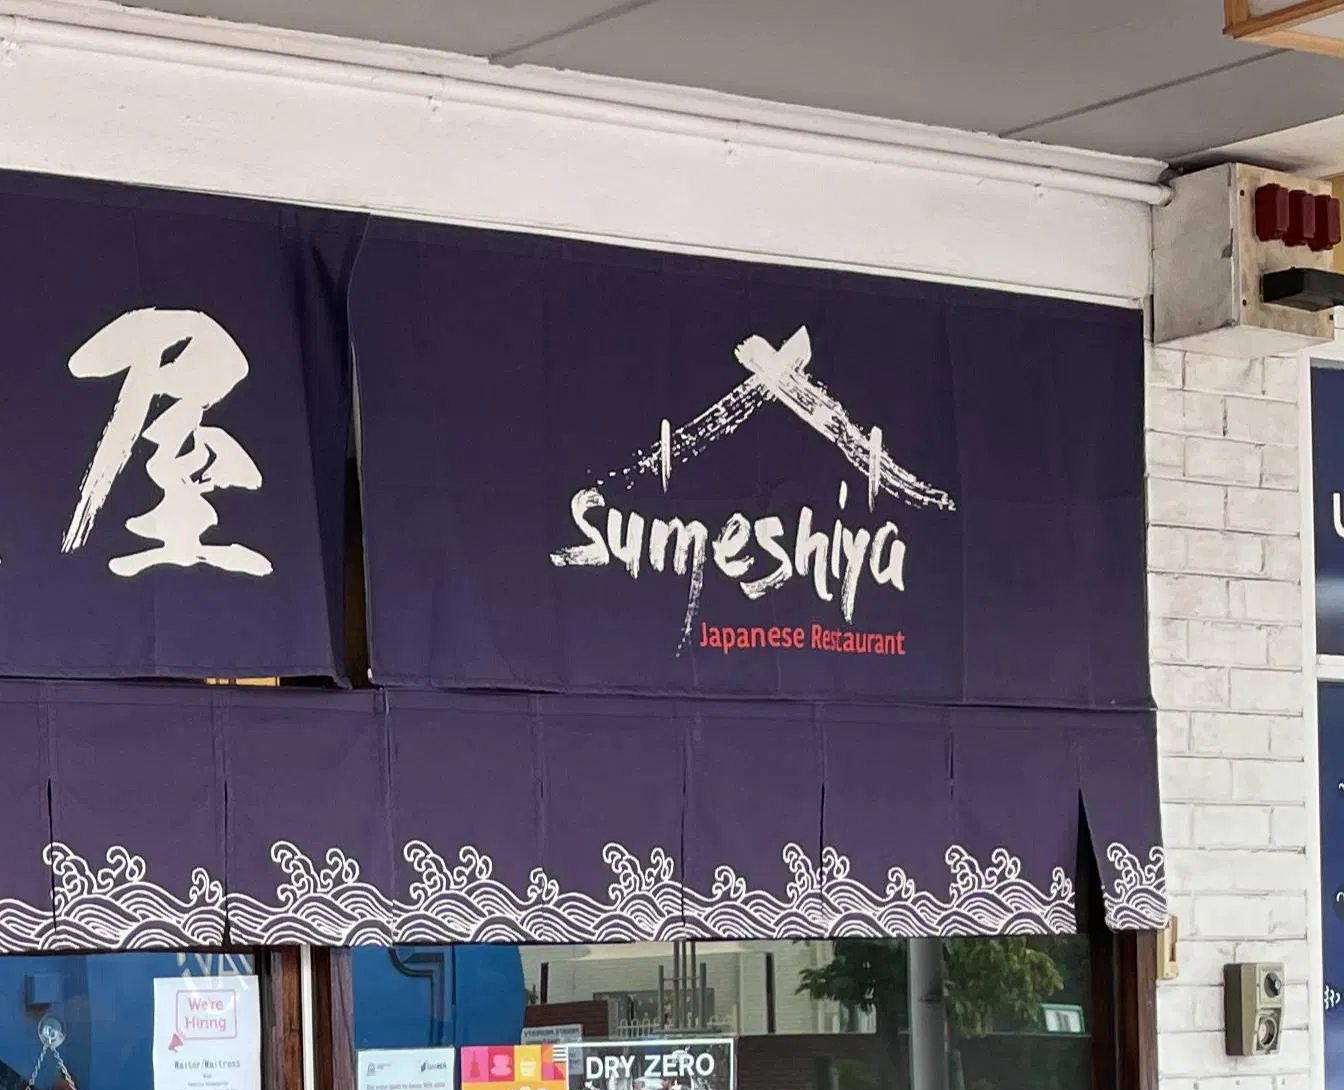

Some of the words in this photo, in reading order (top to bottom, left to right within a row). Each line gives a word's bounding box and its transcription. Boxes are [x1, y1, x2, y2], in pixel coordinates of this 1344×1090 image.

[550, 480, 906, 655] Sumeshiya
[700, 620, 805, 655] Japanese
[810, 624, 906, 656] Restaurant
[187, 997, 224, 1011] We're
[184, 1015, 227, 1033] Hiring
[586, 1055, 636, 1080] DRY
[643, 1052, 716, 1078] ZERO
